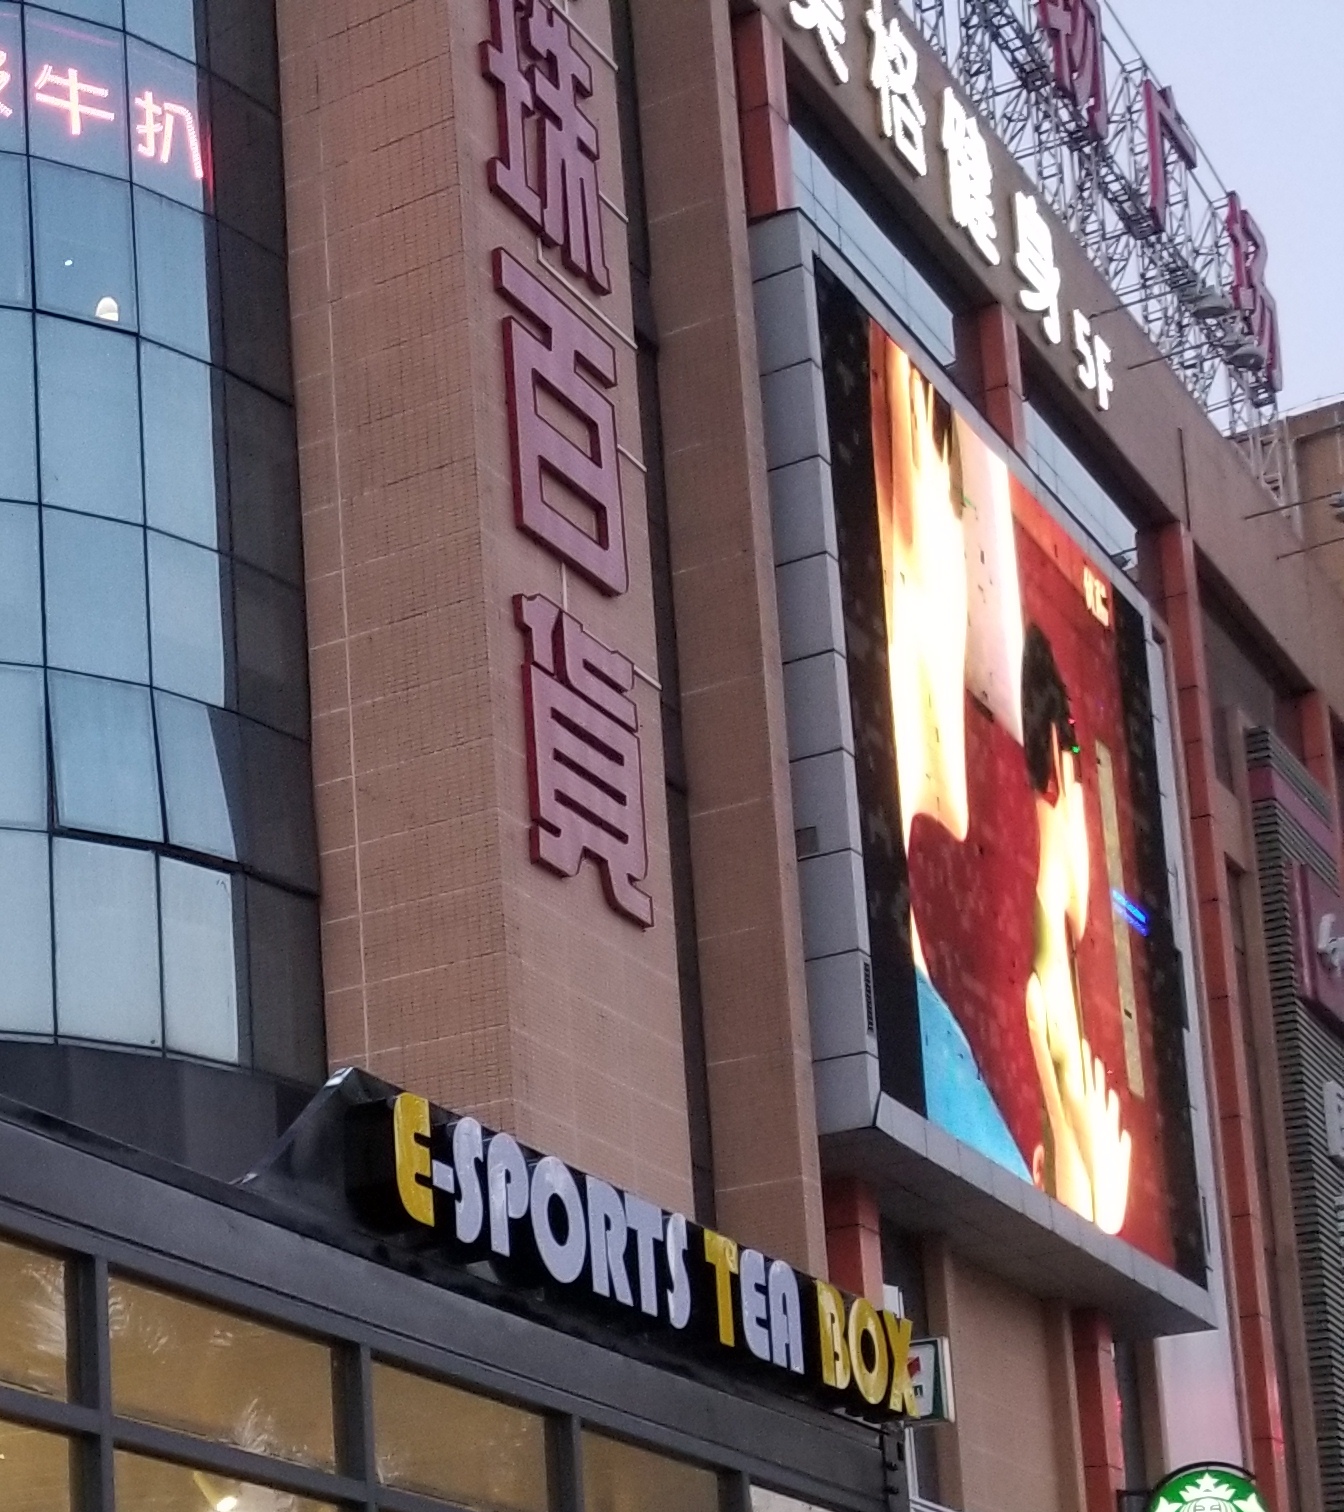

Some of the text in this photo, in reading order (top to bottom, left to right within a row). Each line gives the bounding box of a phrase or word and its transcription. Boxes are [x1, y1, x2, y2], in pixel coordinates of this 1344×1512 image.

[393, 1092, 921, 1419] E-SPORTS TEA BOX
